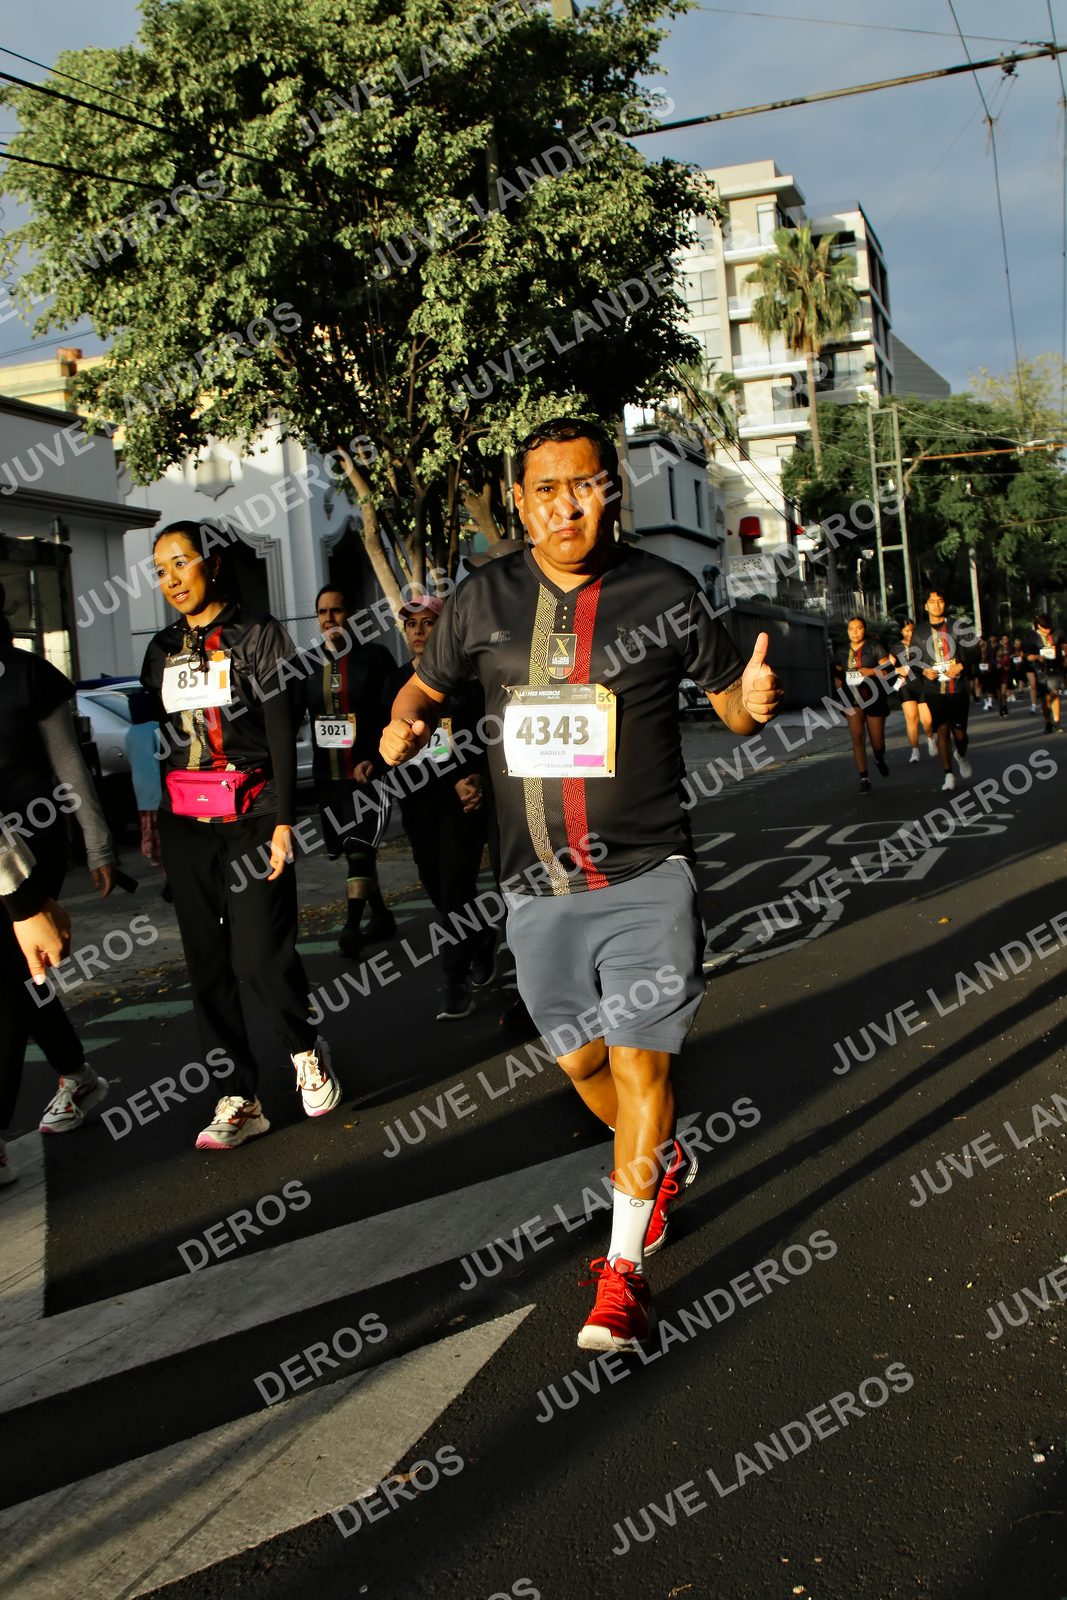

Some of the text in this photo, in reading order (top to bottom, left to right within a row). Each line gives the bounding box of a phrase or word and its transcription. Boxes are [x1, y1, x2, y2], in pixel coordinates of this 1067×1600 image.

[177, 670, 209, 690] 851
[320, 724, 347, 736] 3021
[516, 715, 590, 746] 4343
